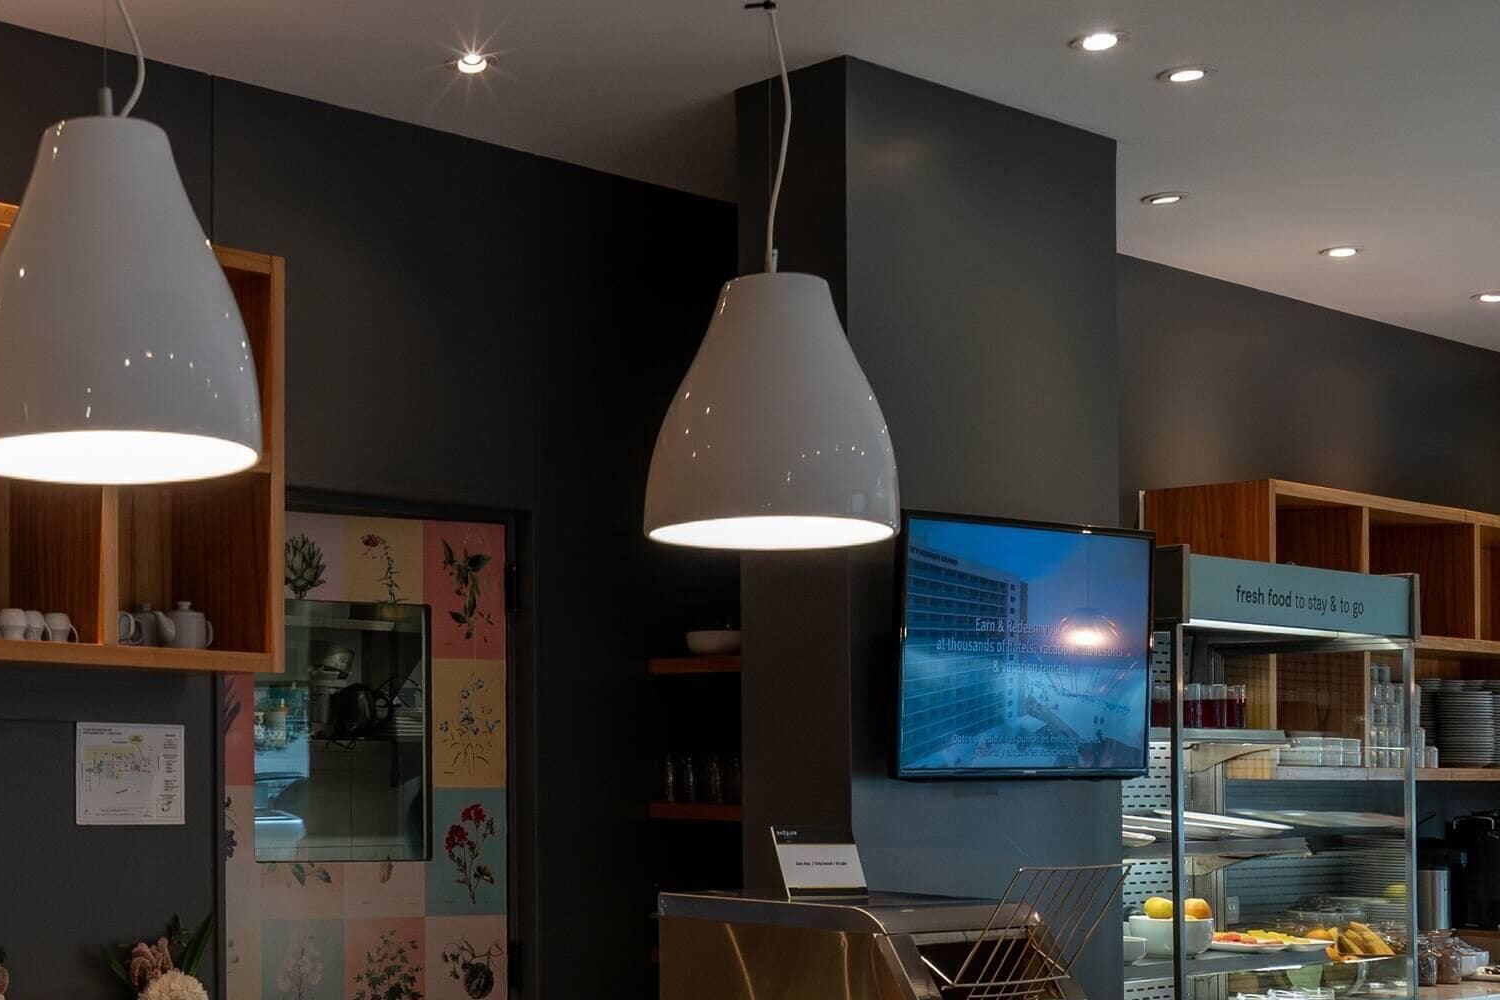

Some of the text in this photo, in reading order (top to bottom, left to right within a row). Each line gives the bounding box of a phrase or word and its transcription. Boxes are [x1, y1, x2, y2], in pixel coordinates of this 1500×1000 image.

[1236, 585, 1364, 619] fresh food to stay & to go
[975, 617, 997, 632] Earn
[997, 619, 1005, 633] &
[1006, 619, 1045, 634] Redeem
[936, 639, 946, 650] at
[947, 638, 995, 653] thousands
[996, 639, 1006, 654] of
